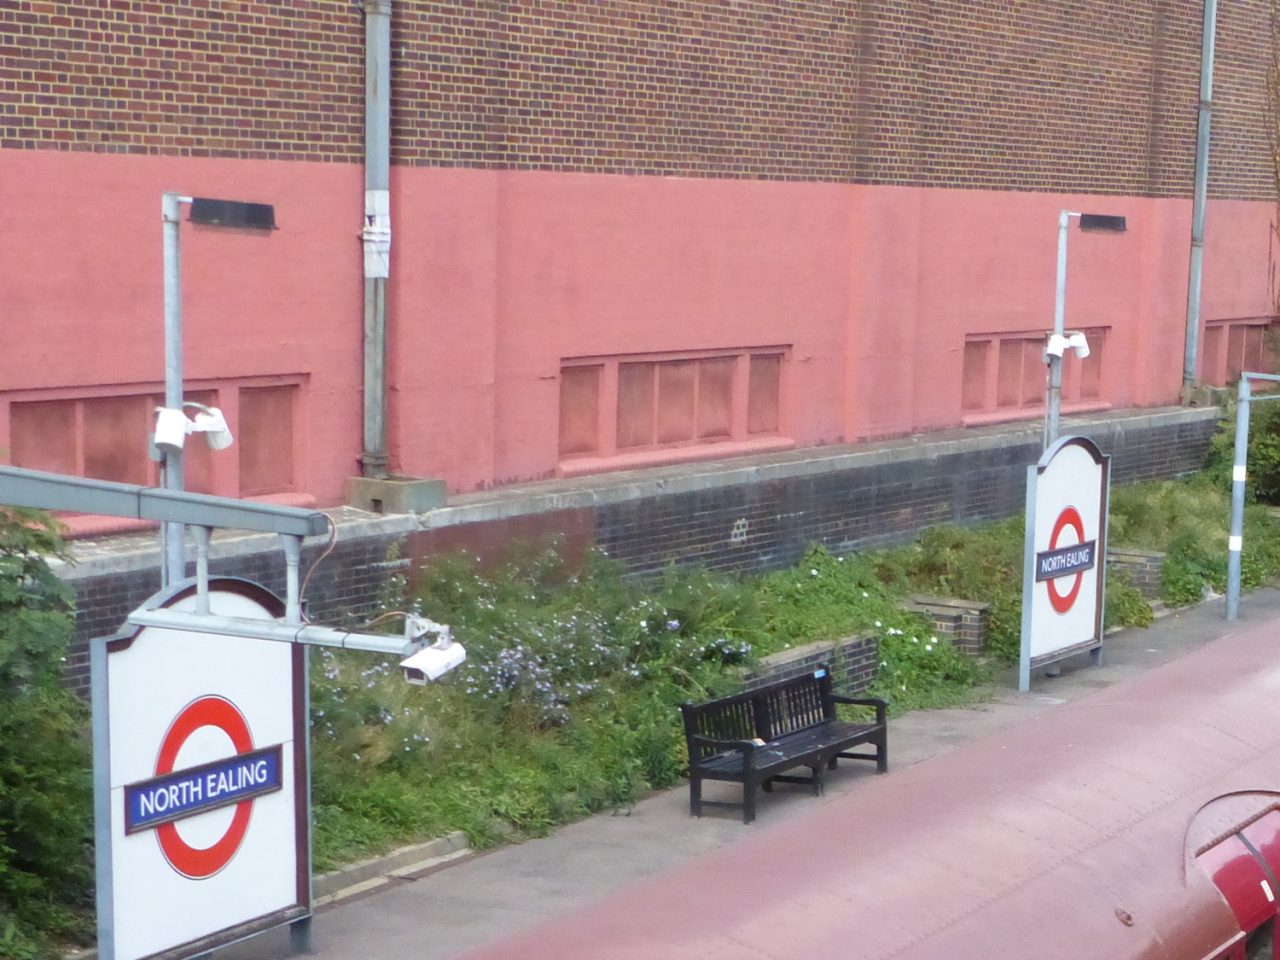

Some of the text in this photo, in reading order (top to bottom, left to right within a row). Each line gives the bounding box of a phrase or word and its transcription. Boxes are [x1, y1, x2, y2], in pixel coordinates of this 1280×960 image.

[1041, 548, 1090, 572] NORTH EALING
[140, 760, 267, 817] NORTH EALING
